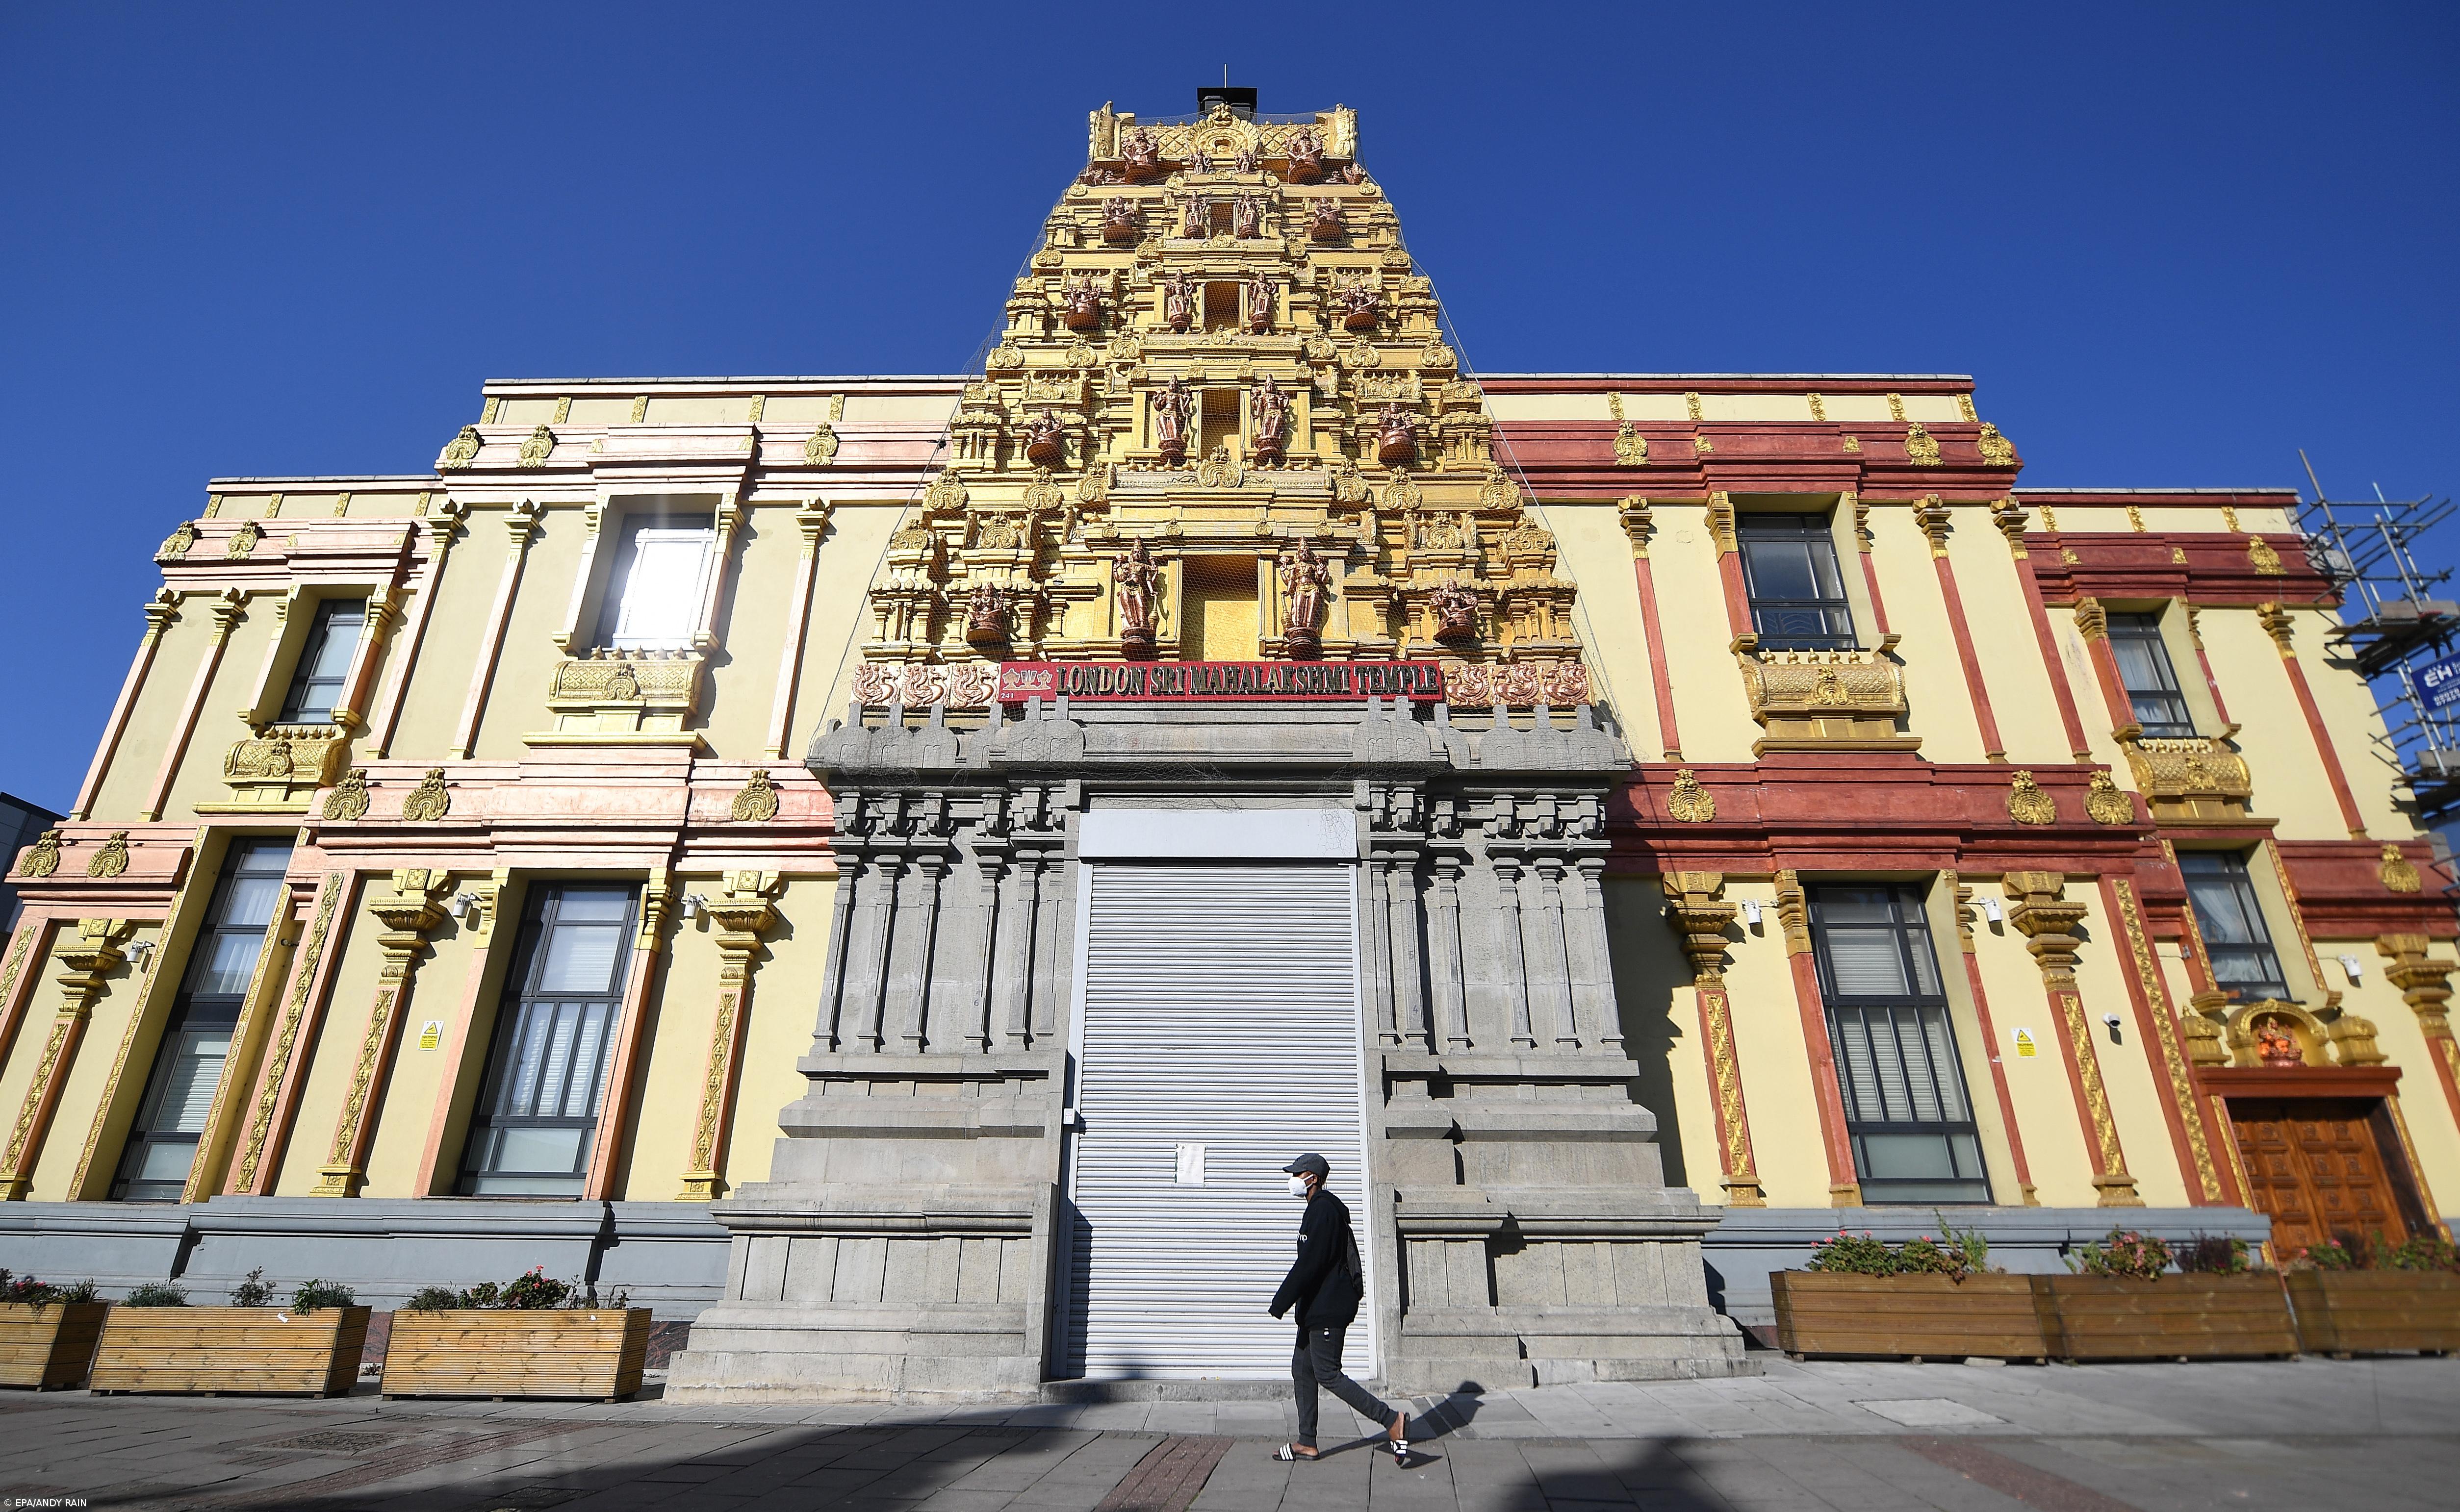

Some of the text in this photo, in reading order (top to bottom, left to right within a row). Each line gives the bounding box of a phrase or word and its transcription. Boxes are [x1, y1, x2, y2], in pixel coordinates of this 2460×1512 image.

[1055, 665, 1440, 695] LONDON SRI MAHALAKSHMI TEMPLE
[1413, 1005, 1418, 1013] 4
